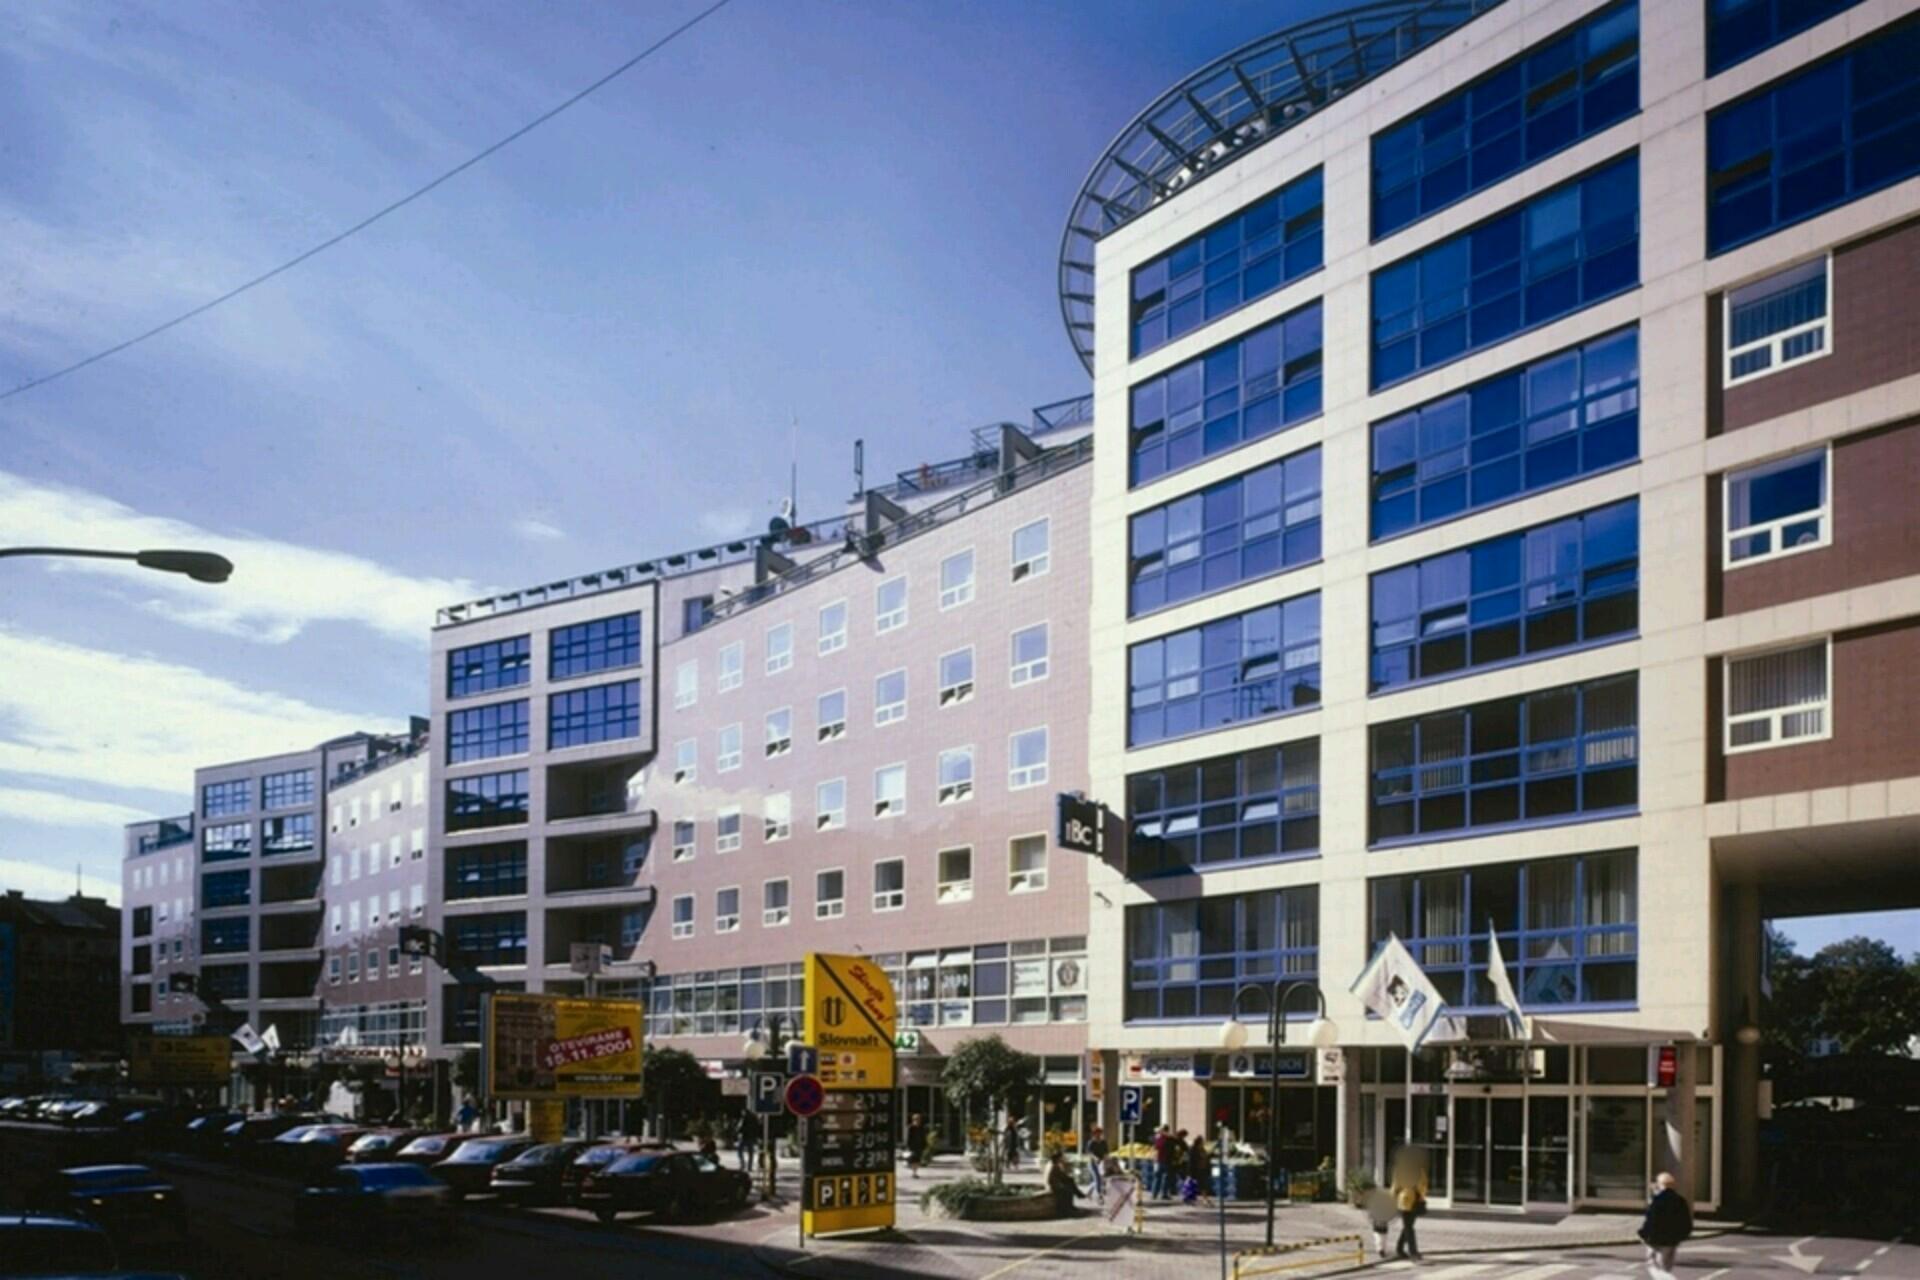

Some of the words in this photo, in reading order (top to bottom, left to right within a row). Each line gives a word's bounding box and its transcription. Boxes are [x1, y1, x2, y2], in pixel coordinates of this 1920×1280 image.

[1065, 817, 1093, 846] IBC
[818, 1032, 879, 1047] Slovnaft
[1123, 1090, 1137, 1111] P
